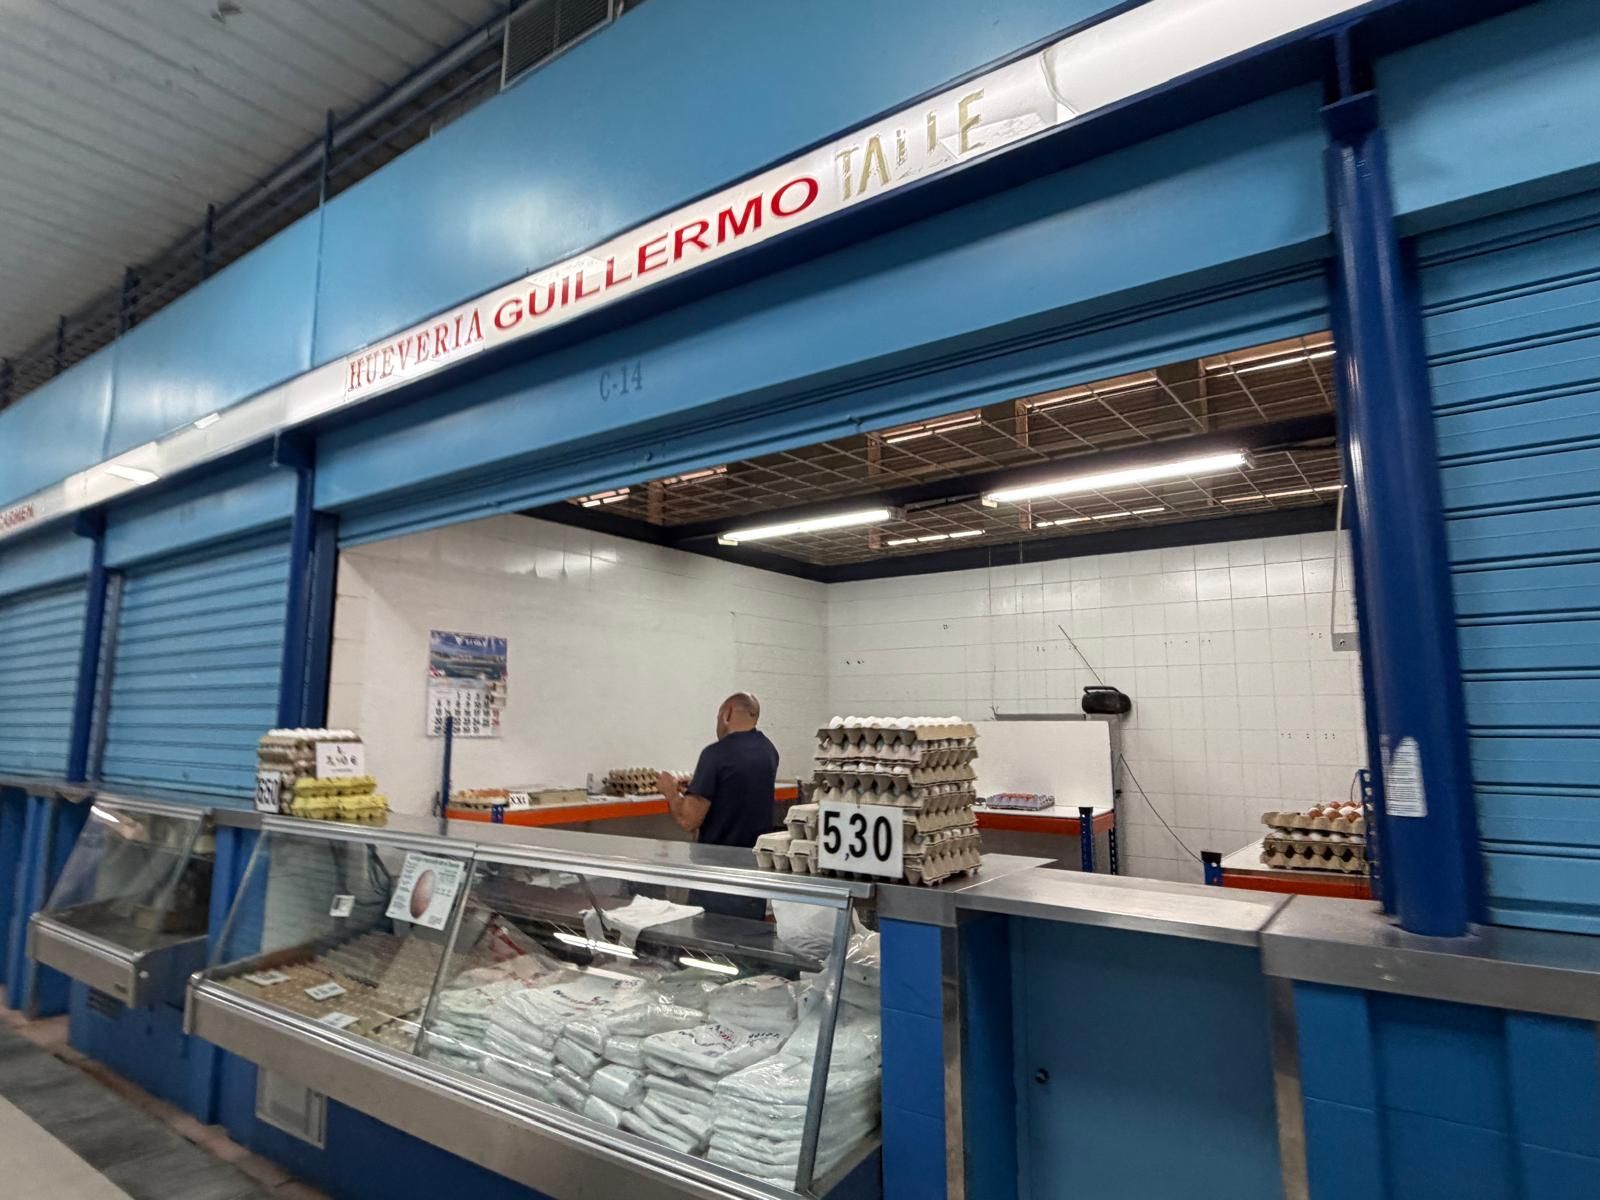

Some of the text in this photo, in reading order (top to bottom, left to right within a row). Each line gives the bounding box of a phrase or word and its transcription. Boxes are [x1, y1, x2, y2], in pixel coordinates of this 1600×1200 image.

[347, 307, 484, 392] HUEVERIA
[494, 177, 819, 331] GUILLERMO
[599, 359, 644, 401] C-14
[823, 810, 893, 862] 5,30
